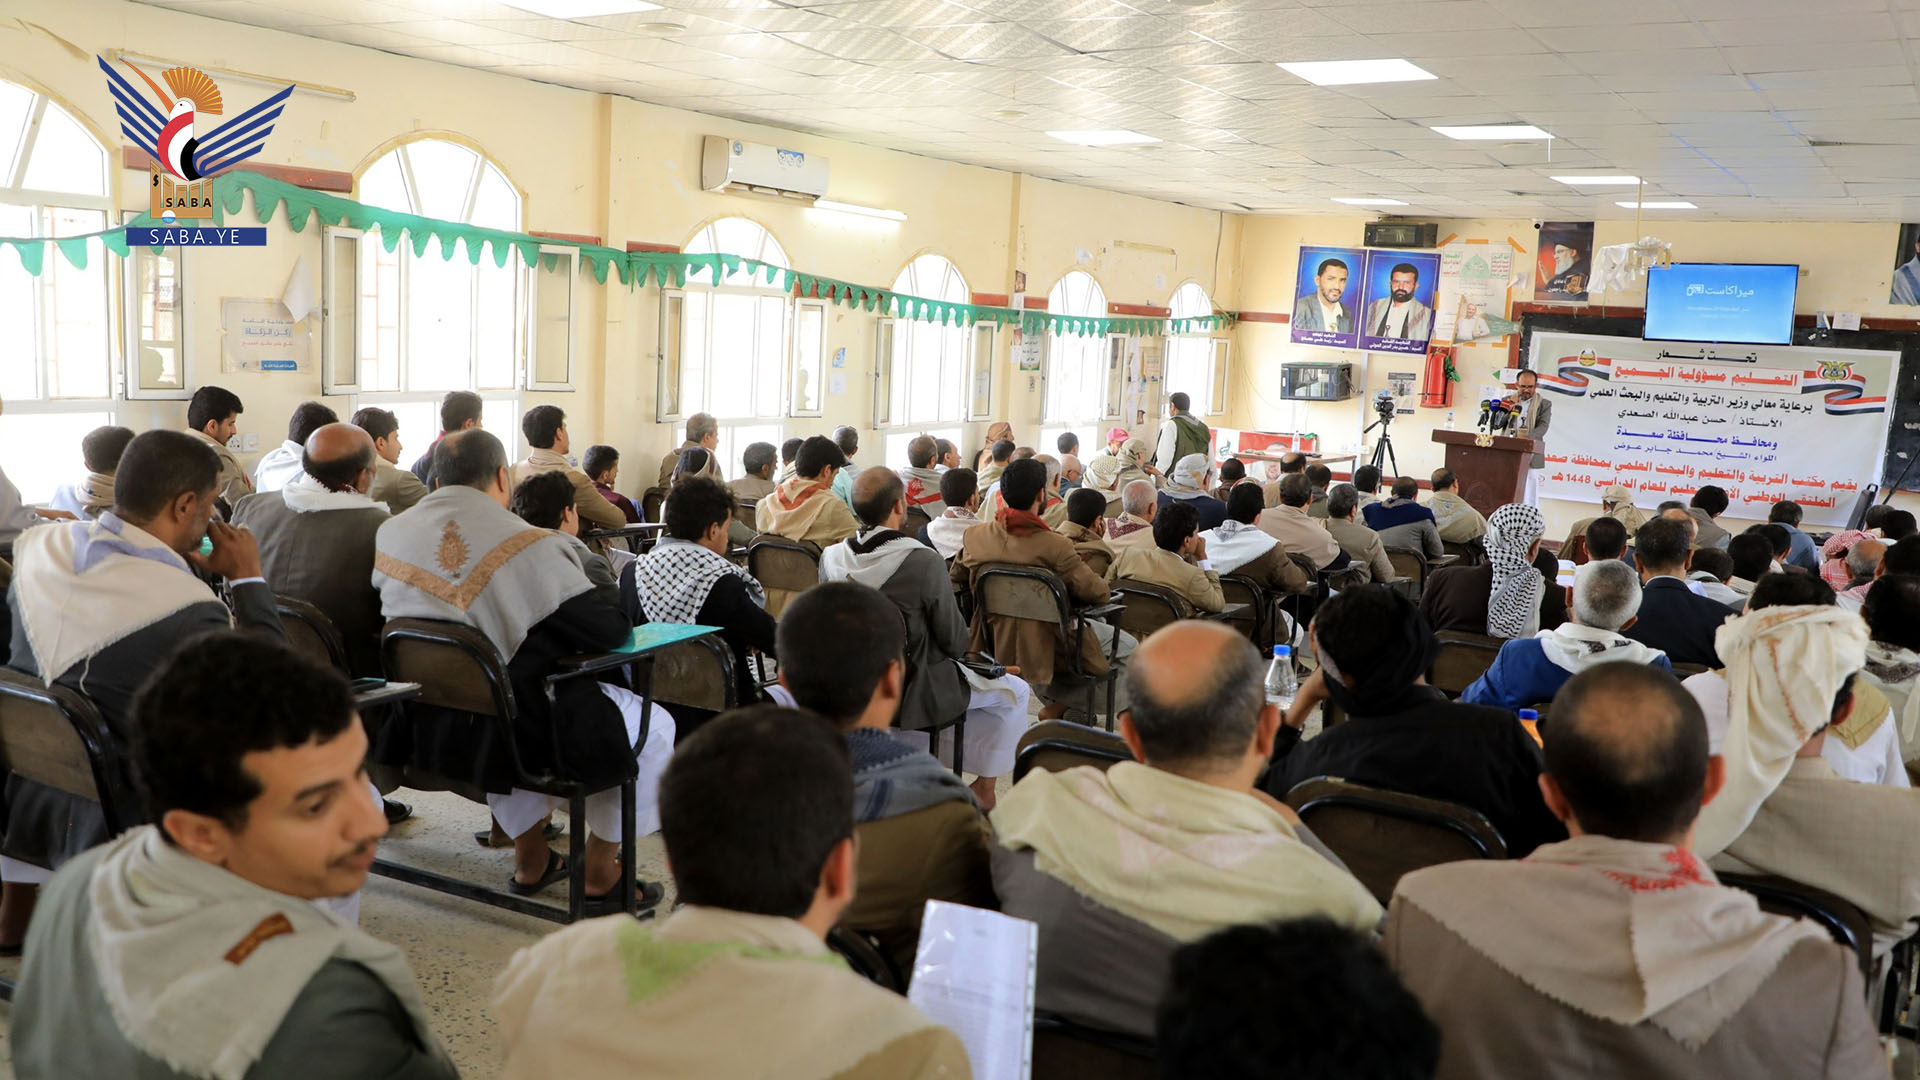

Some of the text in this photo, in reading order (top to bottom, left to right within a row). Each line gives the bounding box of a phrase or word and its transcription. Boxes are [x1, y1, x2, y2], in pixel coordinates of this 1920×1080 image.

[1705, 285, 1754, 298] ميراكاست
[1656, 348, 1757, 363] تحت شعار
[1615, 365, 1798, 387] التعليم مسؤولية الجميع
[1590, 386, 1813, 414] برعاية معالي وزير التربية والتعليم والبحث العلمي
[1618, 409, 1659, 419] الصعدي
[1702, 414, 1727, 424] حسن
[1616, 425, 1778, 450] ومحافظ محافظة صعدة
[1644, 445, 1672, 454] جابر
[1544, 453, 1858, 493] يقيم مكتب التربية والتعليم والبحث العلمي بمحافظة صعد
[1566, 473, 1591, 484] 1448
[1640, 479, 1667, 493] للعام
[1743, 490, 1786, 505] الوطني
